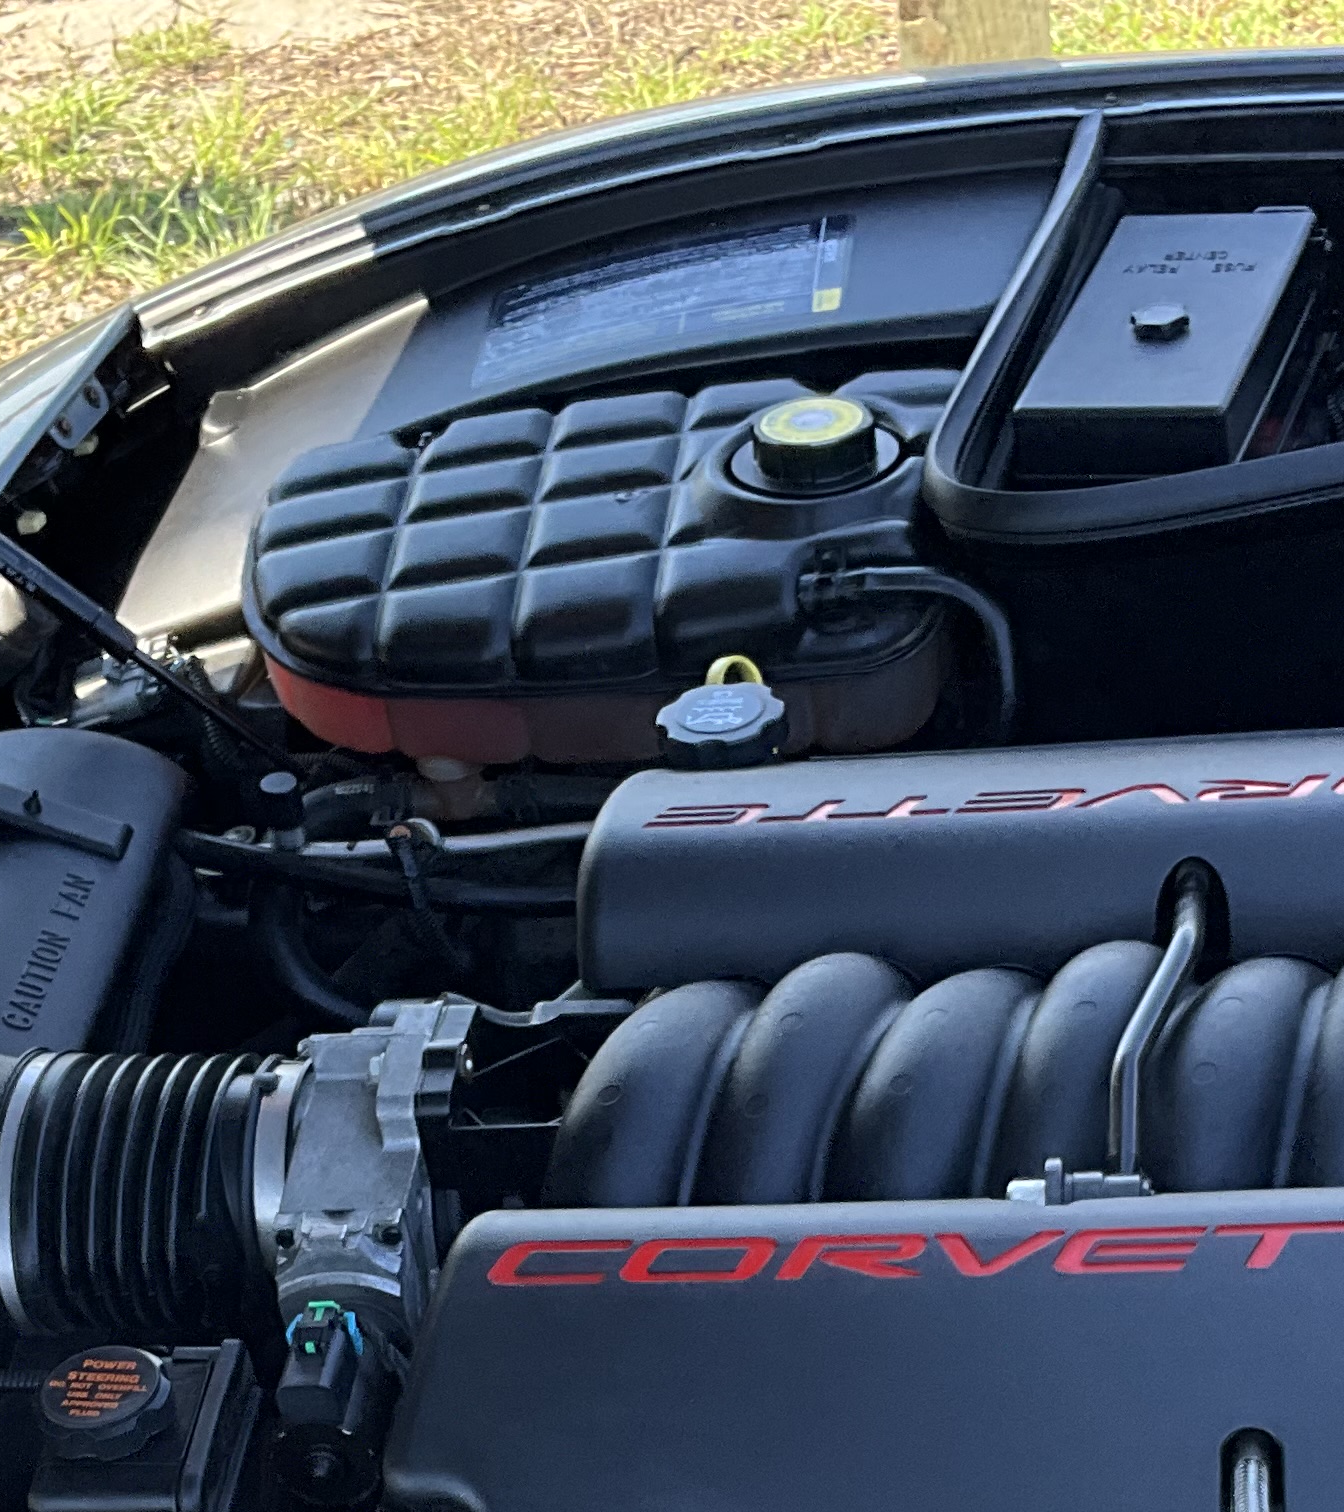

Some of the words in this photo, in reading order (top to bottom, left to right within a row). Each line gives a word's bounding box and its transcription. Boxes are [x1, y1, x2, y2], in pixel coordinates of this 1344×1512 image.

[3, 929, 71, 1034] CAUTION
[53, 872, 97, 923] FAN
[83, 1359, 137, 1370] POWER
[67, 1371, 140, 1384] STEERING
